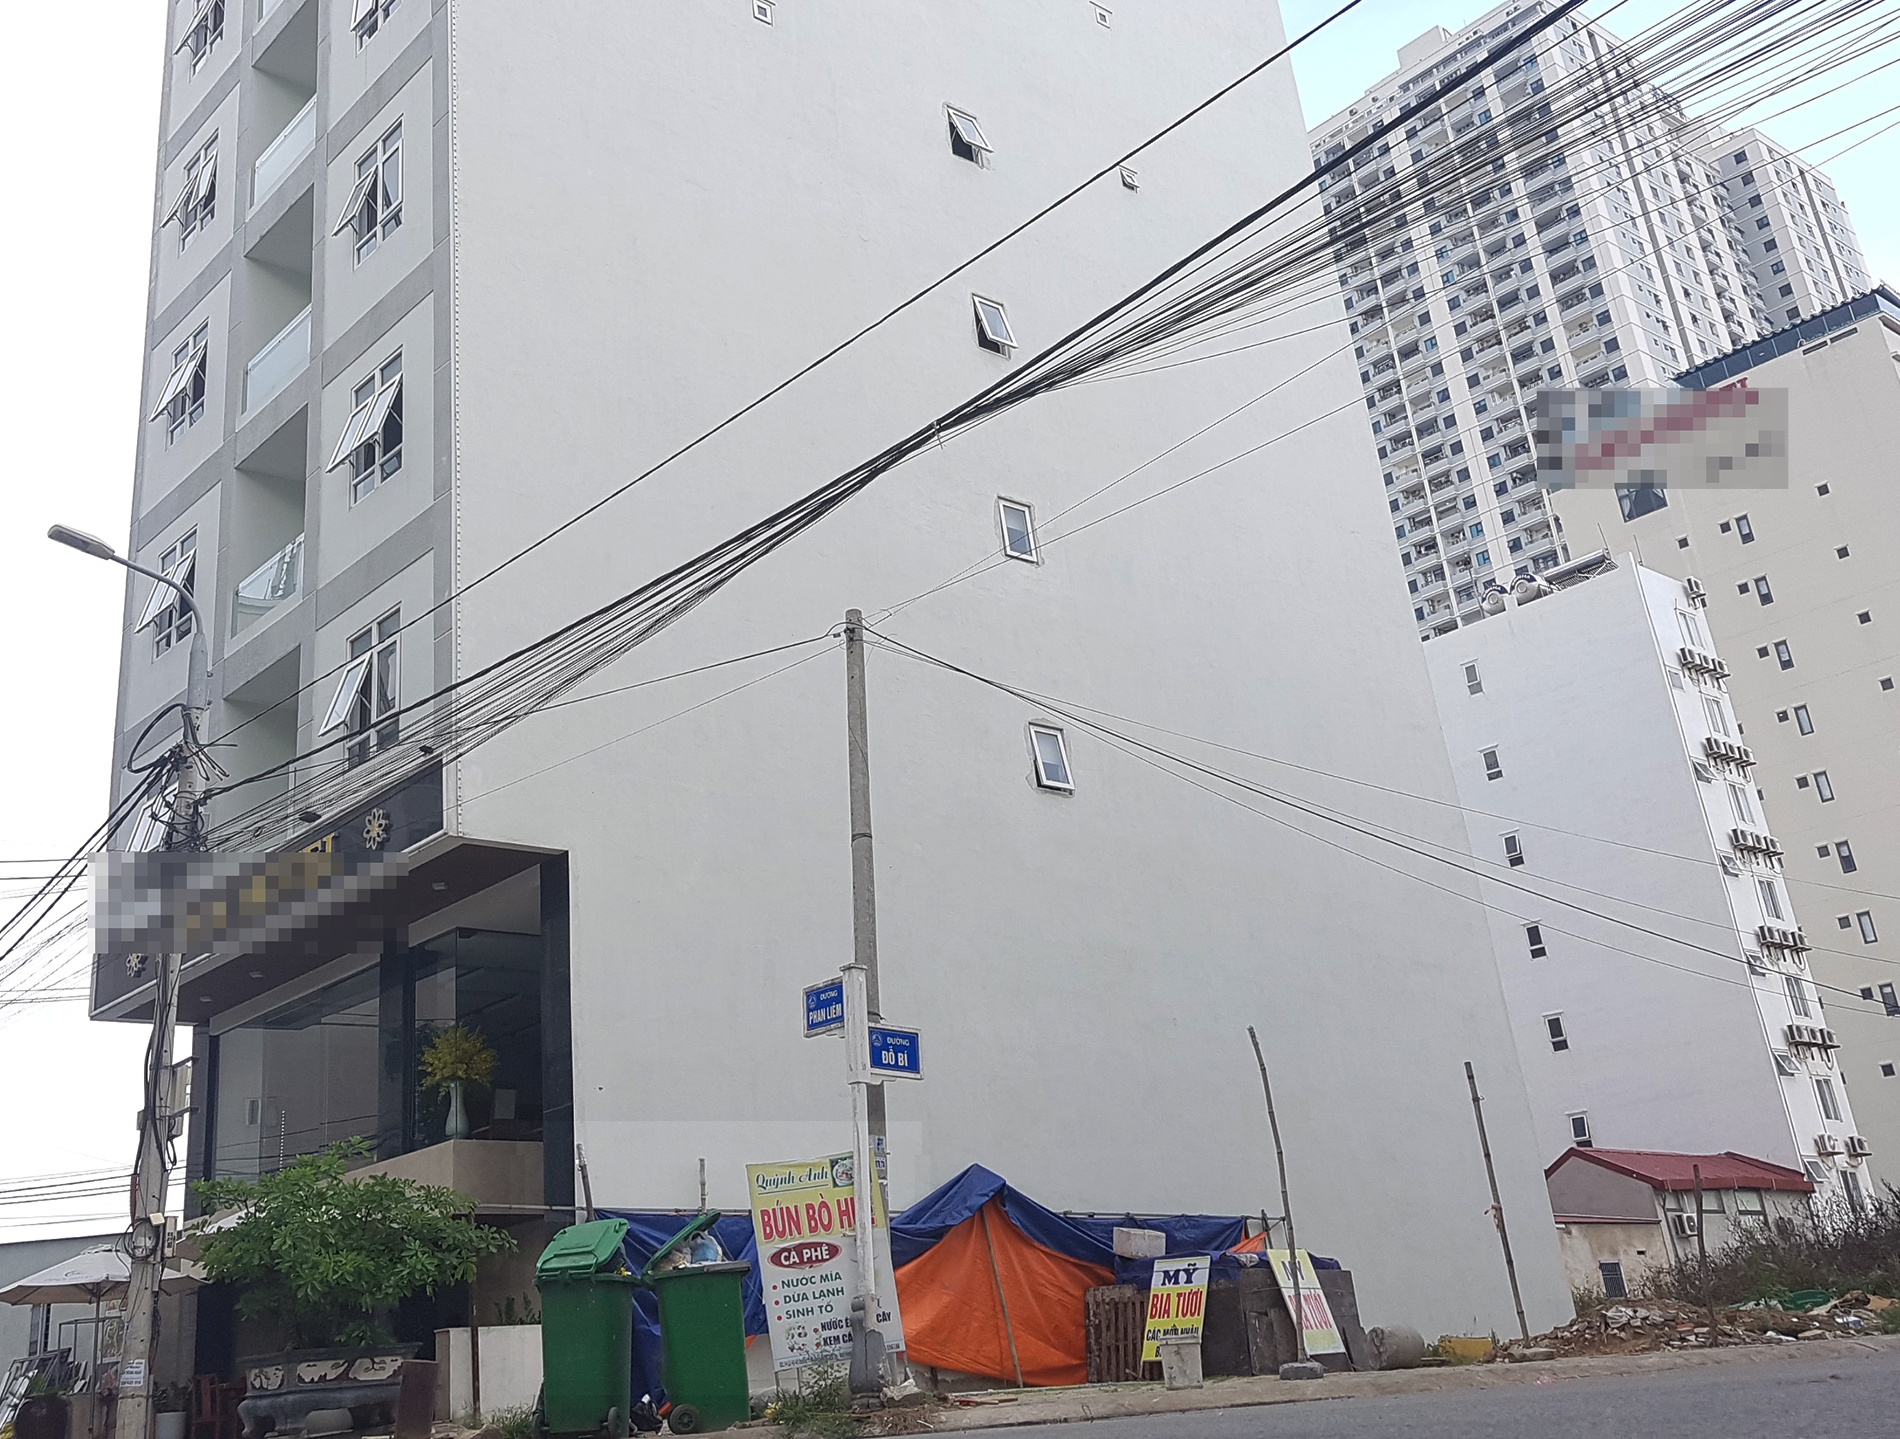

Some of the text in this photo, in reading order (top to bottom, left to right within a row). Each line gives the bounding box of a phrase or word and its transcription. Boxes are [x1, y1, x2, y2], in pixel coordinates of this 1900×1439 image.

[809, 1008, 826, 1025] PHAN
[881, 1046, 908, 1066] ĐỖ BÍ
[799, 1165, 829, 1184] Anh
[760, 1200, 803, 1241] BÚN
[805, 1193, 833, 1235] BÒ
[780, 1243, 830, 1265] CÀ PHÊ
[781, 1274, 816, 1290] NƯỚC
[1161, 1262, 1200, 1286] MỸ
[783, 1286, 845, 1305] DỪA LẠNH
[1149, 1288, 1203, 1320] BIA TƯƠI
[785, 1300, 834, 1320] SINH TỐ
[820, 1317, 844, 1332] NƯỚC
[822, 1334, 841, 1347] KEM
